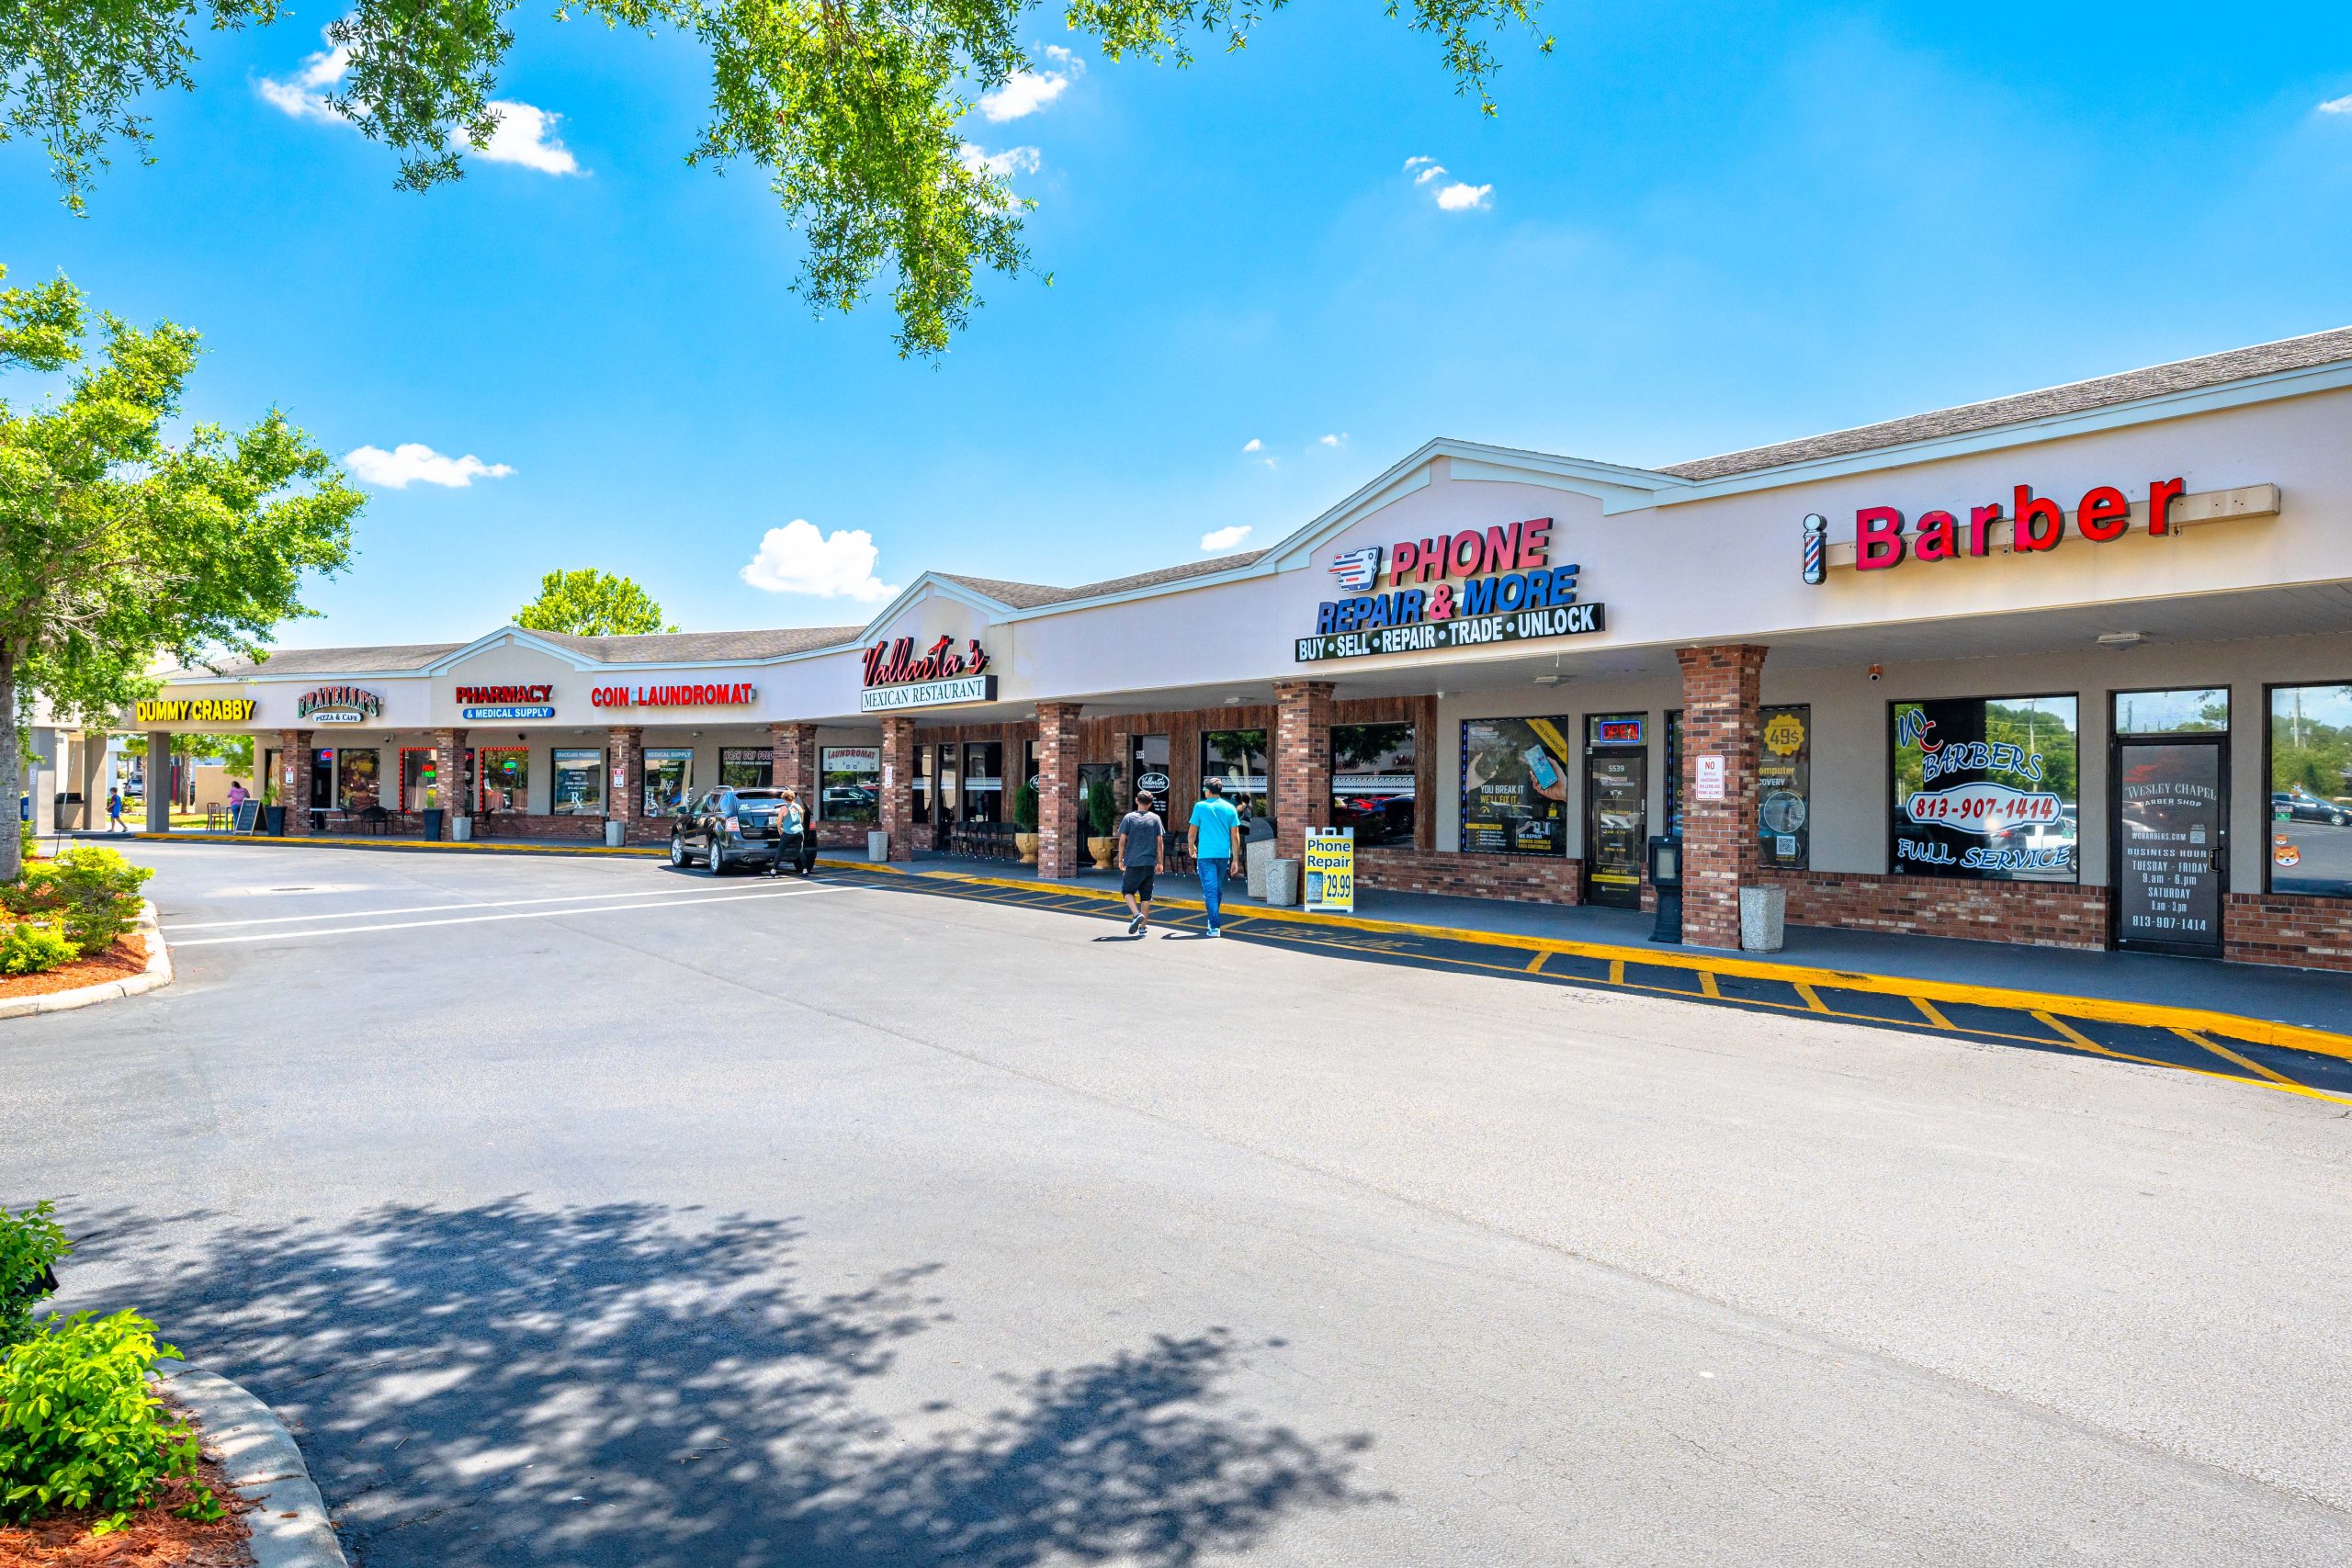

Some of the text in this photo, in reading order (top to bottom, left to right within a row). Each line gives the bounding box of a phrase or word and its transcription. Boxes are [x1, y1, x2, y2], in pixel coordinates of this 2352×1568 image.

[1856, 477, 2186, 571] Barber
[1389, 517, 1553, 587] PHONE
[1316, 563, 1580, 635] REPAIR & MORE
[1298, 604, 1596, 661] BUY SELL REPAIR TRADE UNLOCK
[298, 685, 380, 718] FRATELLI'S
[456, 684, 553, 705] PHARMACY
[592, 682, 752, 707] COIN LAUNDROMAT
[864, 680, 984, 708] MEXICAN RESTAURANT
[137, 699, 256, 722] DUMMY CRABBY
[316, 714, 334, 722] PIZZA
[335, 713, 340, 721] &
[467, 707, 549, 718] & MEDICAL SUPPLY
[1602, 724, 1638, 740] OPEN
[827, 749, 876, 760] LAUNDROMAT
[1923, 741, 2042, 782] BARBERS
[1608, 764, 1625, 773] 5539
[1705, 761, 1715, 770] NO
[1480, 784, 1524, 795] YOU BREAK IT
[2125, 783, 2217, 801] WESLEY CHAPEL
[1499, 795, 1510, 804] FIX
[1510, 795, 1517, 805] IT
[1916, 797, 2052, 819] 813-907-1414
[2177, 798, 2202, 807] SHOP
[1307, 840, 1351, 852] Phone
[1898, 839, 2072, 869] FULL SERVICE
[1307, 855, 1351, 870] Repair
[2132, 860, 2168, 872] TUESDAY
[2178, 862, 2208, 874] FRIDAY
[2148, 886, 2190, 899] SATURDAY
[2132, 915, 2206, 931] 813-907-1414
